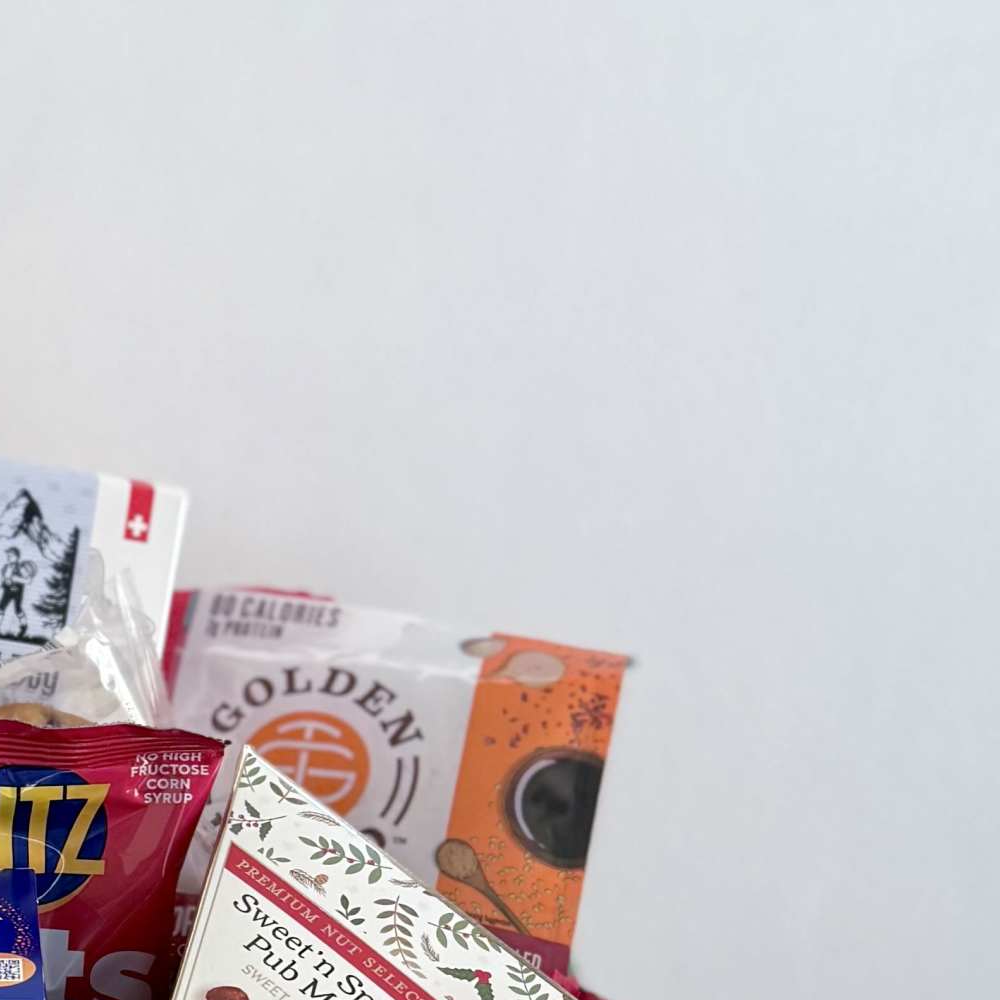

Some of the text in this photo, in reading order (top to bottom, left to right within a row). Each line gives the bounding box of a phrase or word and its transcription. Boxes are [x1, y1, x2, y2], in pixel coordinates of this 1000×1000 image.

[211, 665, 424, 747] GOLDEN
[130, 763, 210, 778] FRUCTOSE
[162, 751, 202, 762] HIGH
[143, 792, 193, 804] SYRUP
[146, 778, 191, 790] CORN
[235, 859, 320, 923] PREMIUM
[320, 923, 363, 957] NUT
[232, 893, 336, 978] Sweet'n
[242, 934, 299, 982] Pub
